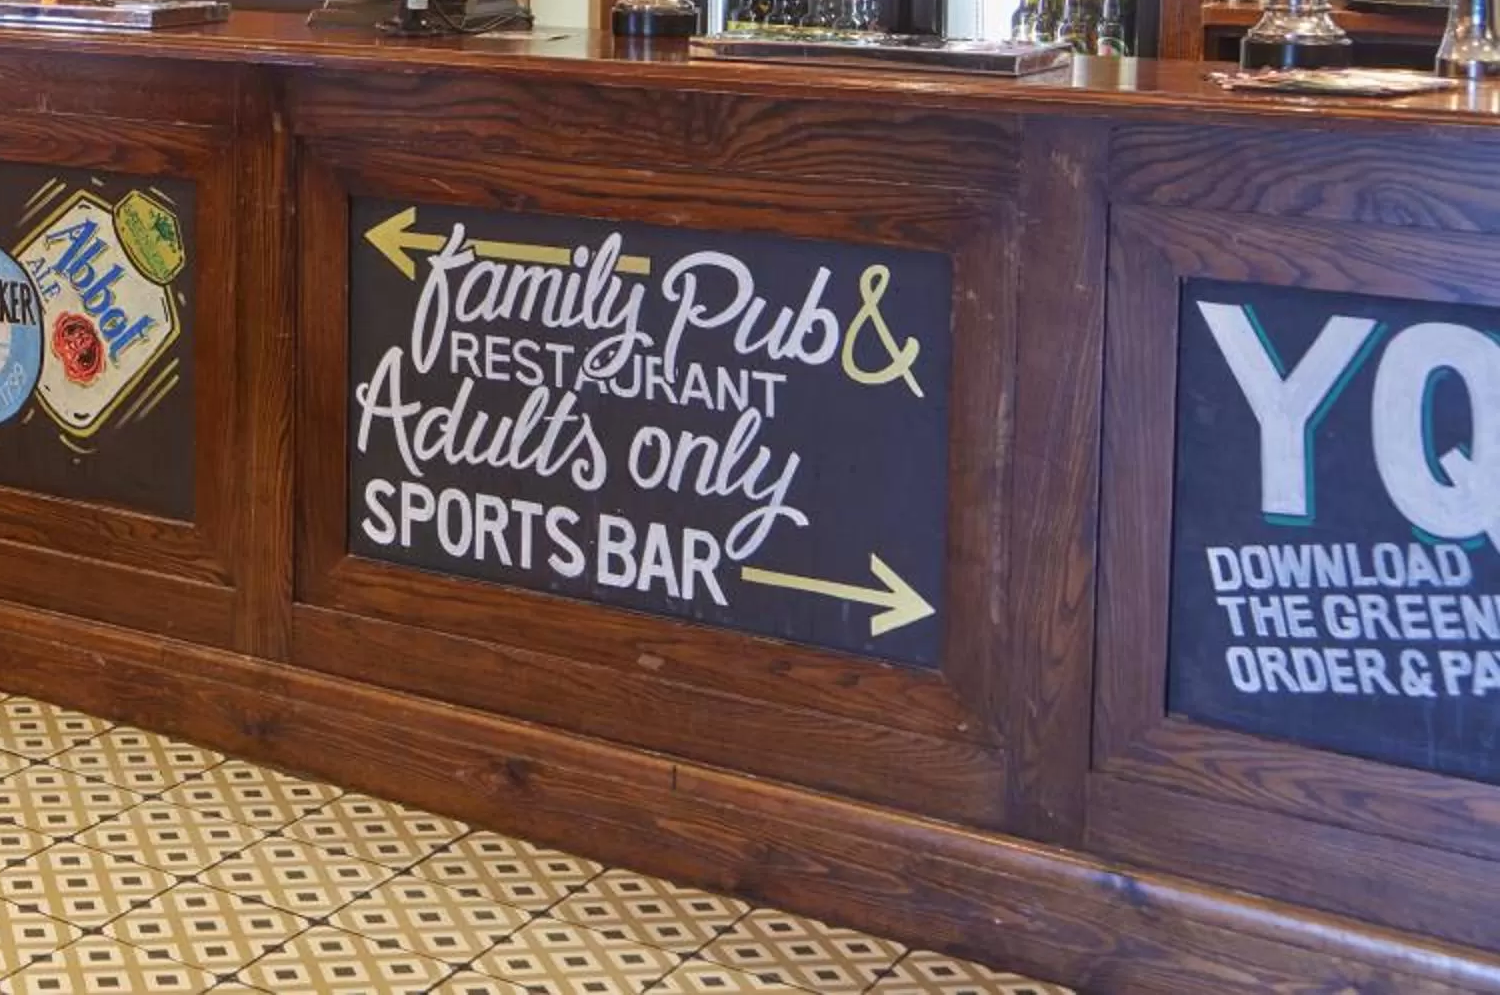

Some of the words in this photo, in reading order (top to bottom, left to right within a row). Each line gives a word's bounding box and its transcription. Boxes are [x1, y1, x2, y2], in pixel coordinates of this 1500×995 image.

[28, 256, 61, 300] ALE
[44, 217, 157, 369] Abbot
[662, 250, 839, 383] Pub
[841, 264, 924, 398] &
[449, 331, 787, 418] RESTAURANT
[355, 346, 607, 493] Adults
[627, 407, 809, 561] only
[361, 478, 587, 578] SPORTS
[598, 513, 728, 605] BAR
[1207, 543, 1472, 591] DOWNLOAD
[1217, 596, 1317, 638] THE
[1322, 595, 1500, 640] GREEN
[1225, 647, 1400, 696] ORDER
[1401, 648, 1438, 697] &
[1438, 650, 1500, 696] PA
